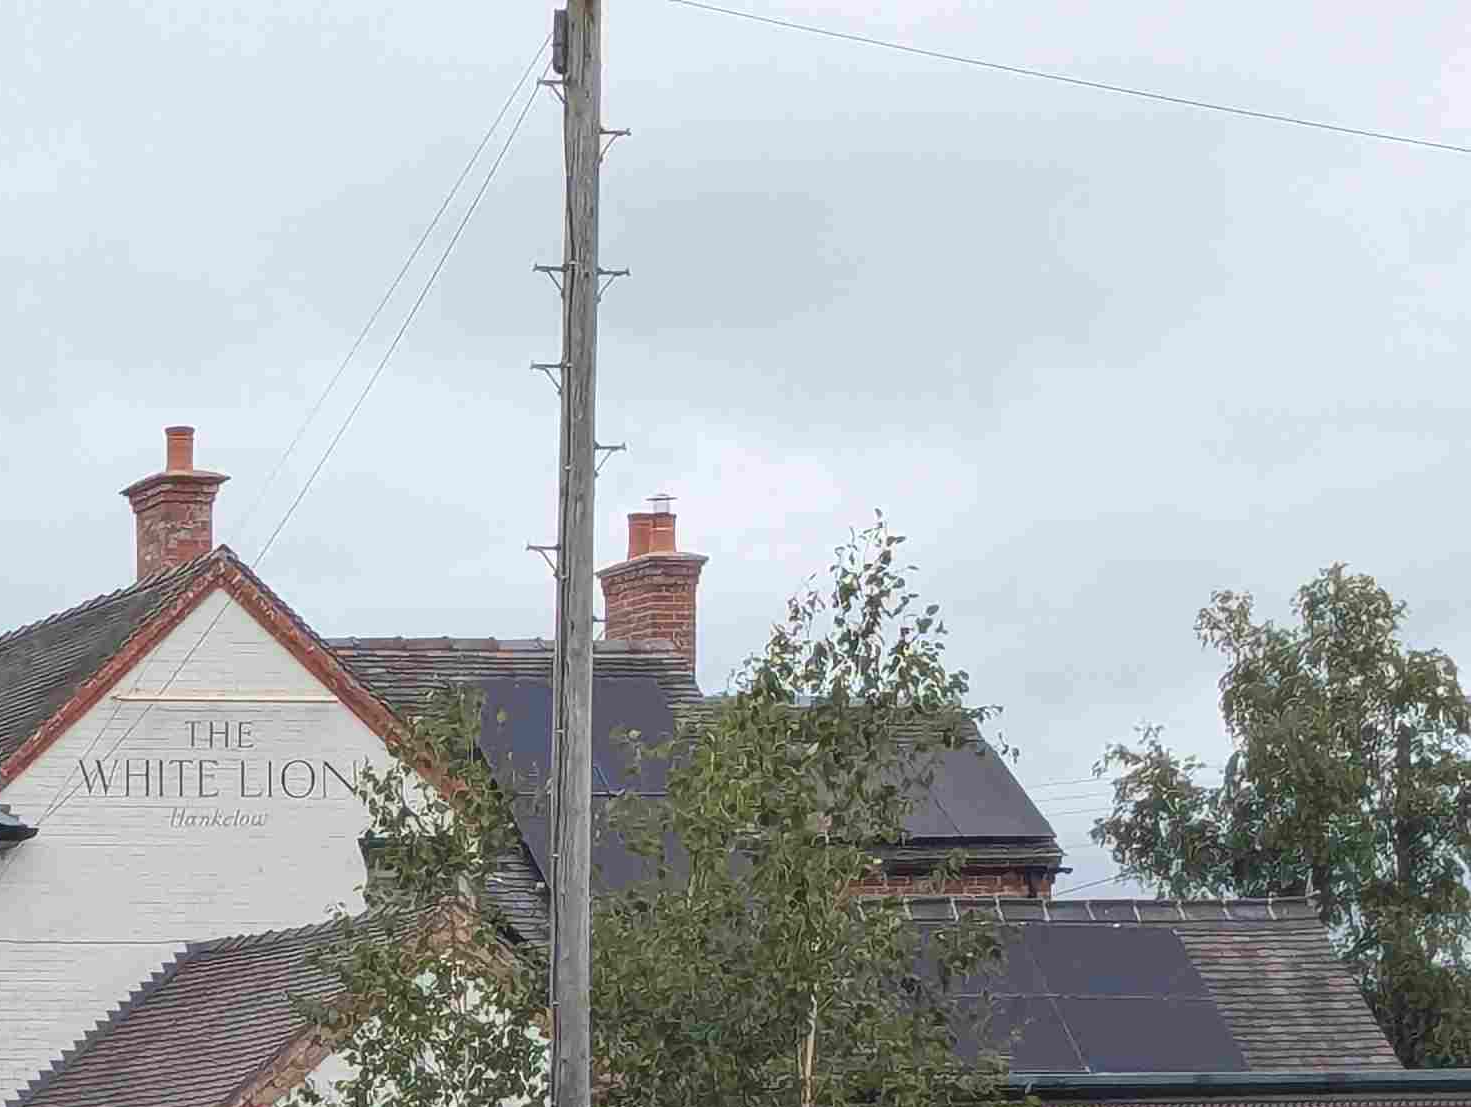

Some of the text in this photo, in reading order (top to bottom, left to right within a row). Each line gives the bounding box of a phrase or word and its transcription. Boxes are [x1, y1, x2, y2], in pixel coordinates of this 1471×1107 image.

[184, 720, 255, 749] THE
[78, 759, 358, 799] WHITE LION
[169, 807, 267, 827] Hankelow
